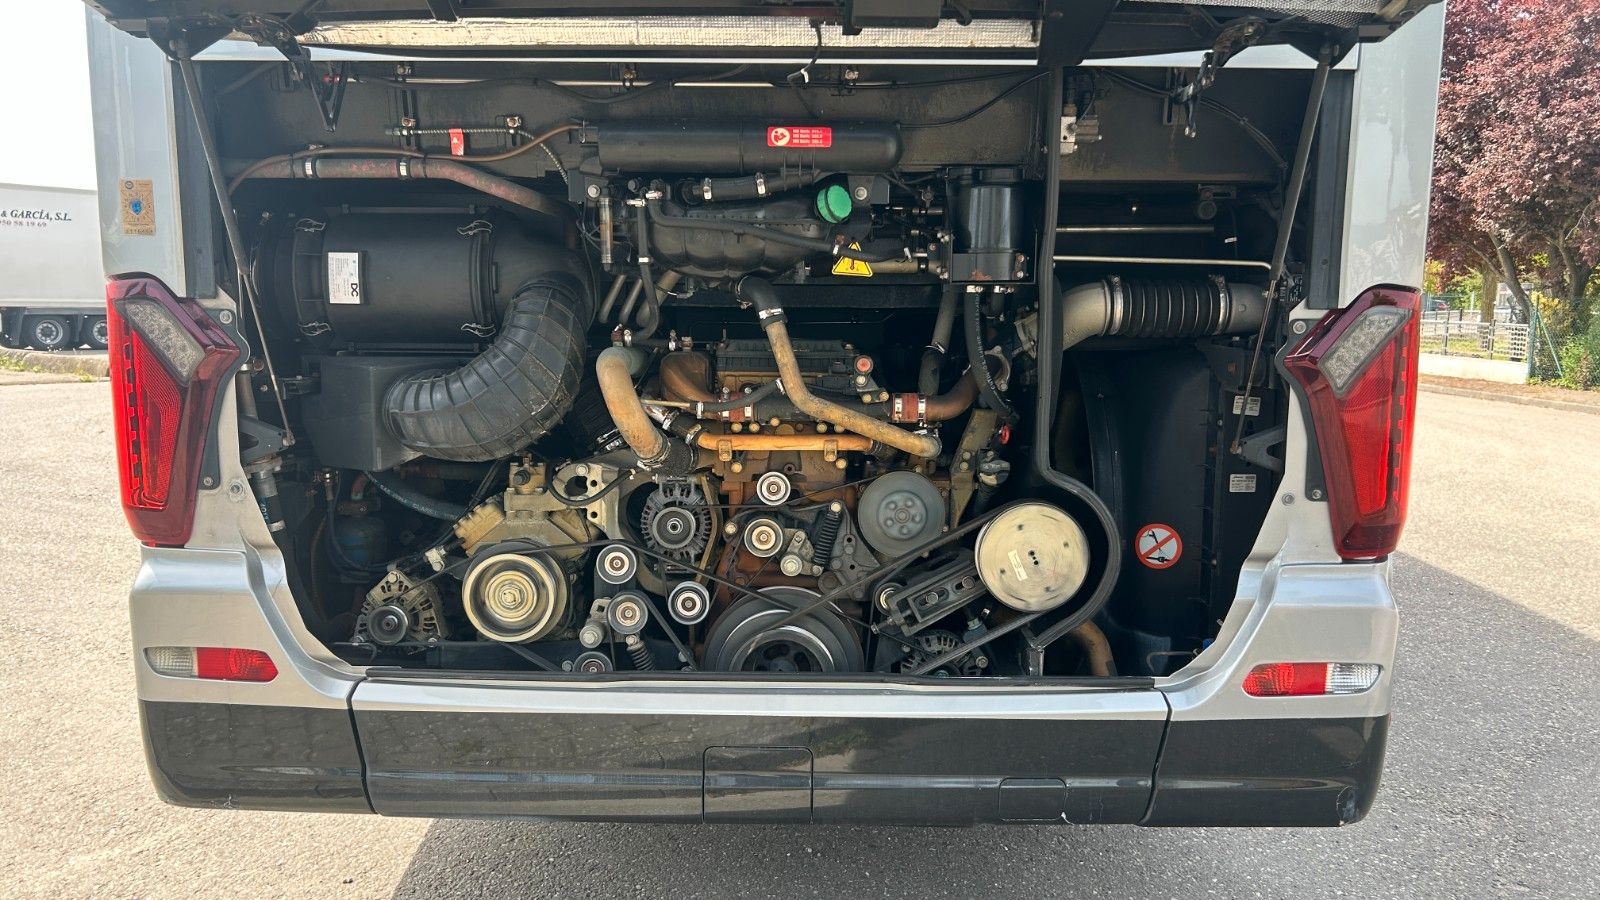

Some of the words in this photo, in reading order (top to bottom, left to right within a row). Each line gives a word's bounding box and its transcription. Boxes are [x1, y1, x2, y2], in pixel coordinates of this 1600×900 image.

[0, 210, 7, 218] &
[10, 209, 53, 221] GARCÍA,
[351, 283, 359, 297] DC
